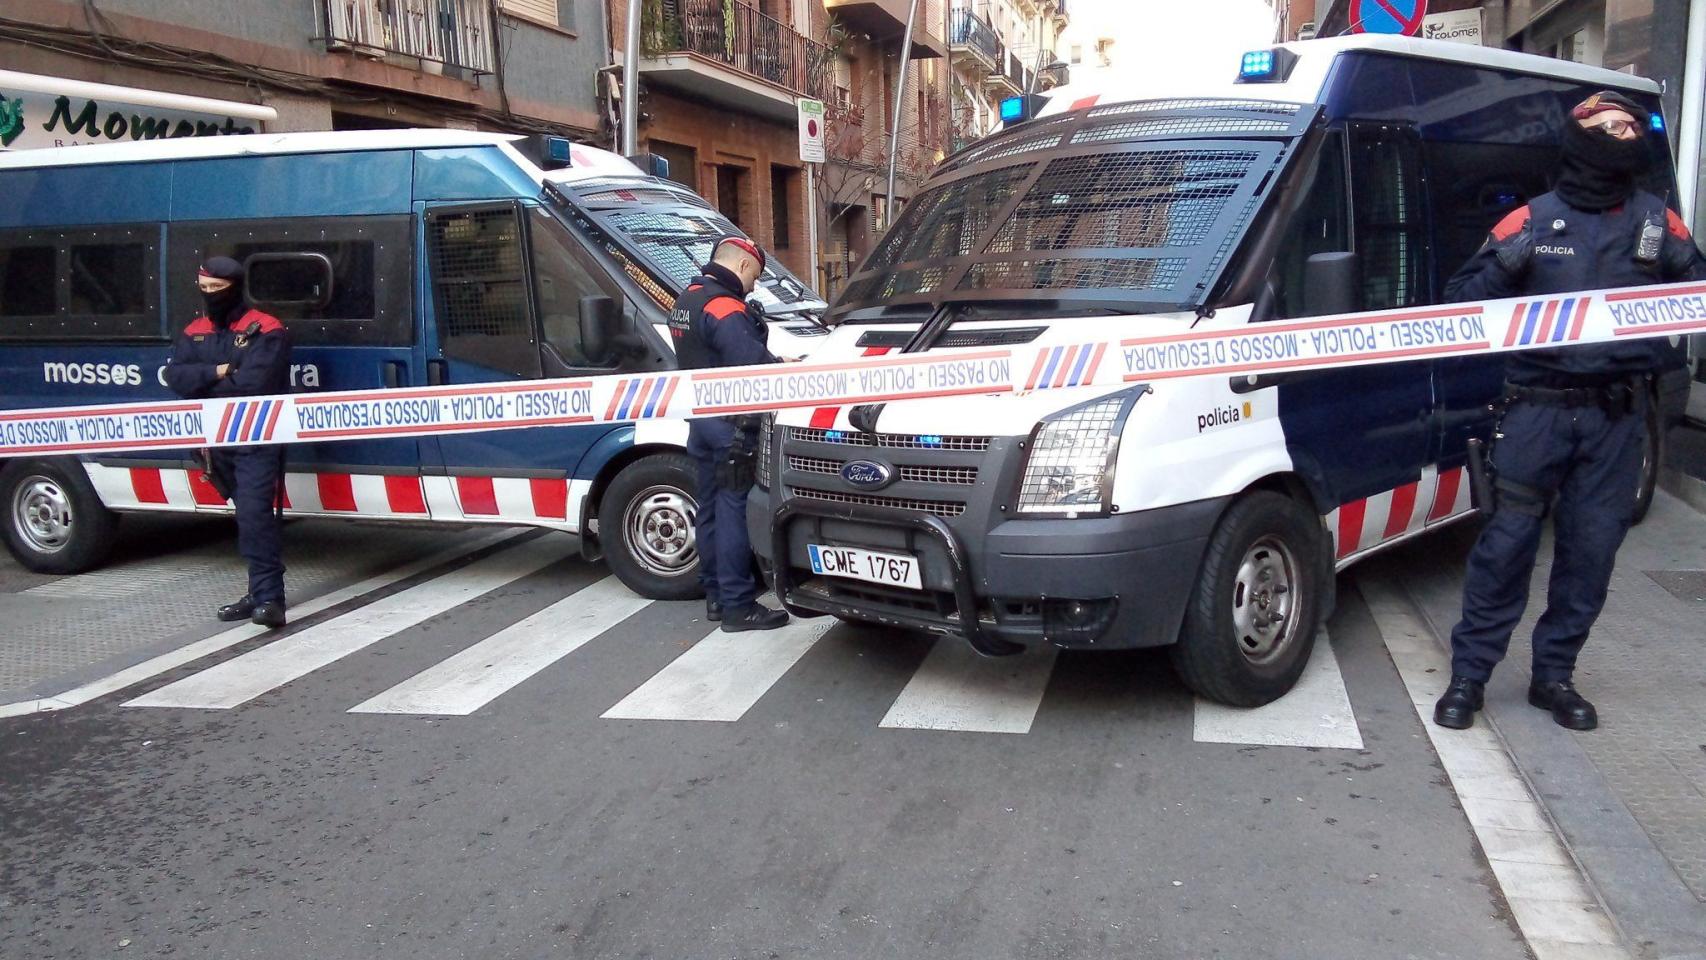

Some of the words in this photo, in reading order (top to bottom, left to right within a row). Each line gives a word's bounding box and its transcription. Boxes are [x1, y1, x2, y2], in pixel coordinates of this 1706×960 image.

[1435, 27, 1479, 40] COLOMER
[1535, 245, 1575, 256] POLICIA
[1312, 326, 1377, 355] POLICIA
[1391, 318, 1455, 349] PASSEU
[1462, 315, 1485, 340] NO
[1124, 340, 1226, 372] D'ESQUADRA
[1231, 334, 1298, 362] MOSSOS
[859, 366, 915, 392] POLICIA
[929, 361, 984, 387] PASSEU
[989, 359, 1010, 382] NO
[693, 377, 783, 406] D'ESQUADRA
[788, 372, 847, 398] MOSSOS
[385, 399, 440, 425] MOSSOS
[452, 396, 504, 421] POLICIA
[516, 390, 568, 417] PASSEU
[572, 390, 591, 413] NO
[76, 417, 124, 441] POLICIA
[134, 413, 180, 438] PASSEU
[186, 412, 203, 435] NO
[296, 402, 381, 430] D'ESQUADRA
[1198, 404, 1239, 433] policia
[18, 420, 69, 444] MOSSOS
[848, 465, 877, 482] Ford
[822, 550, 859, 575] CME
[867, 555, 910, 583] 1767
